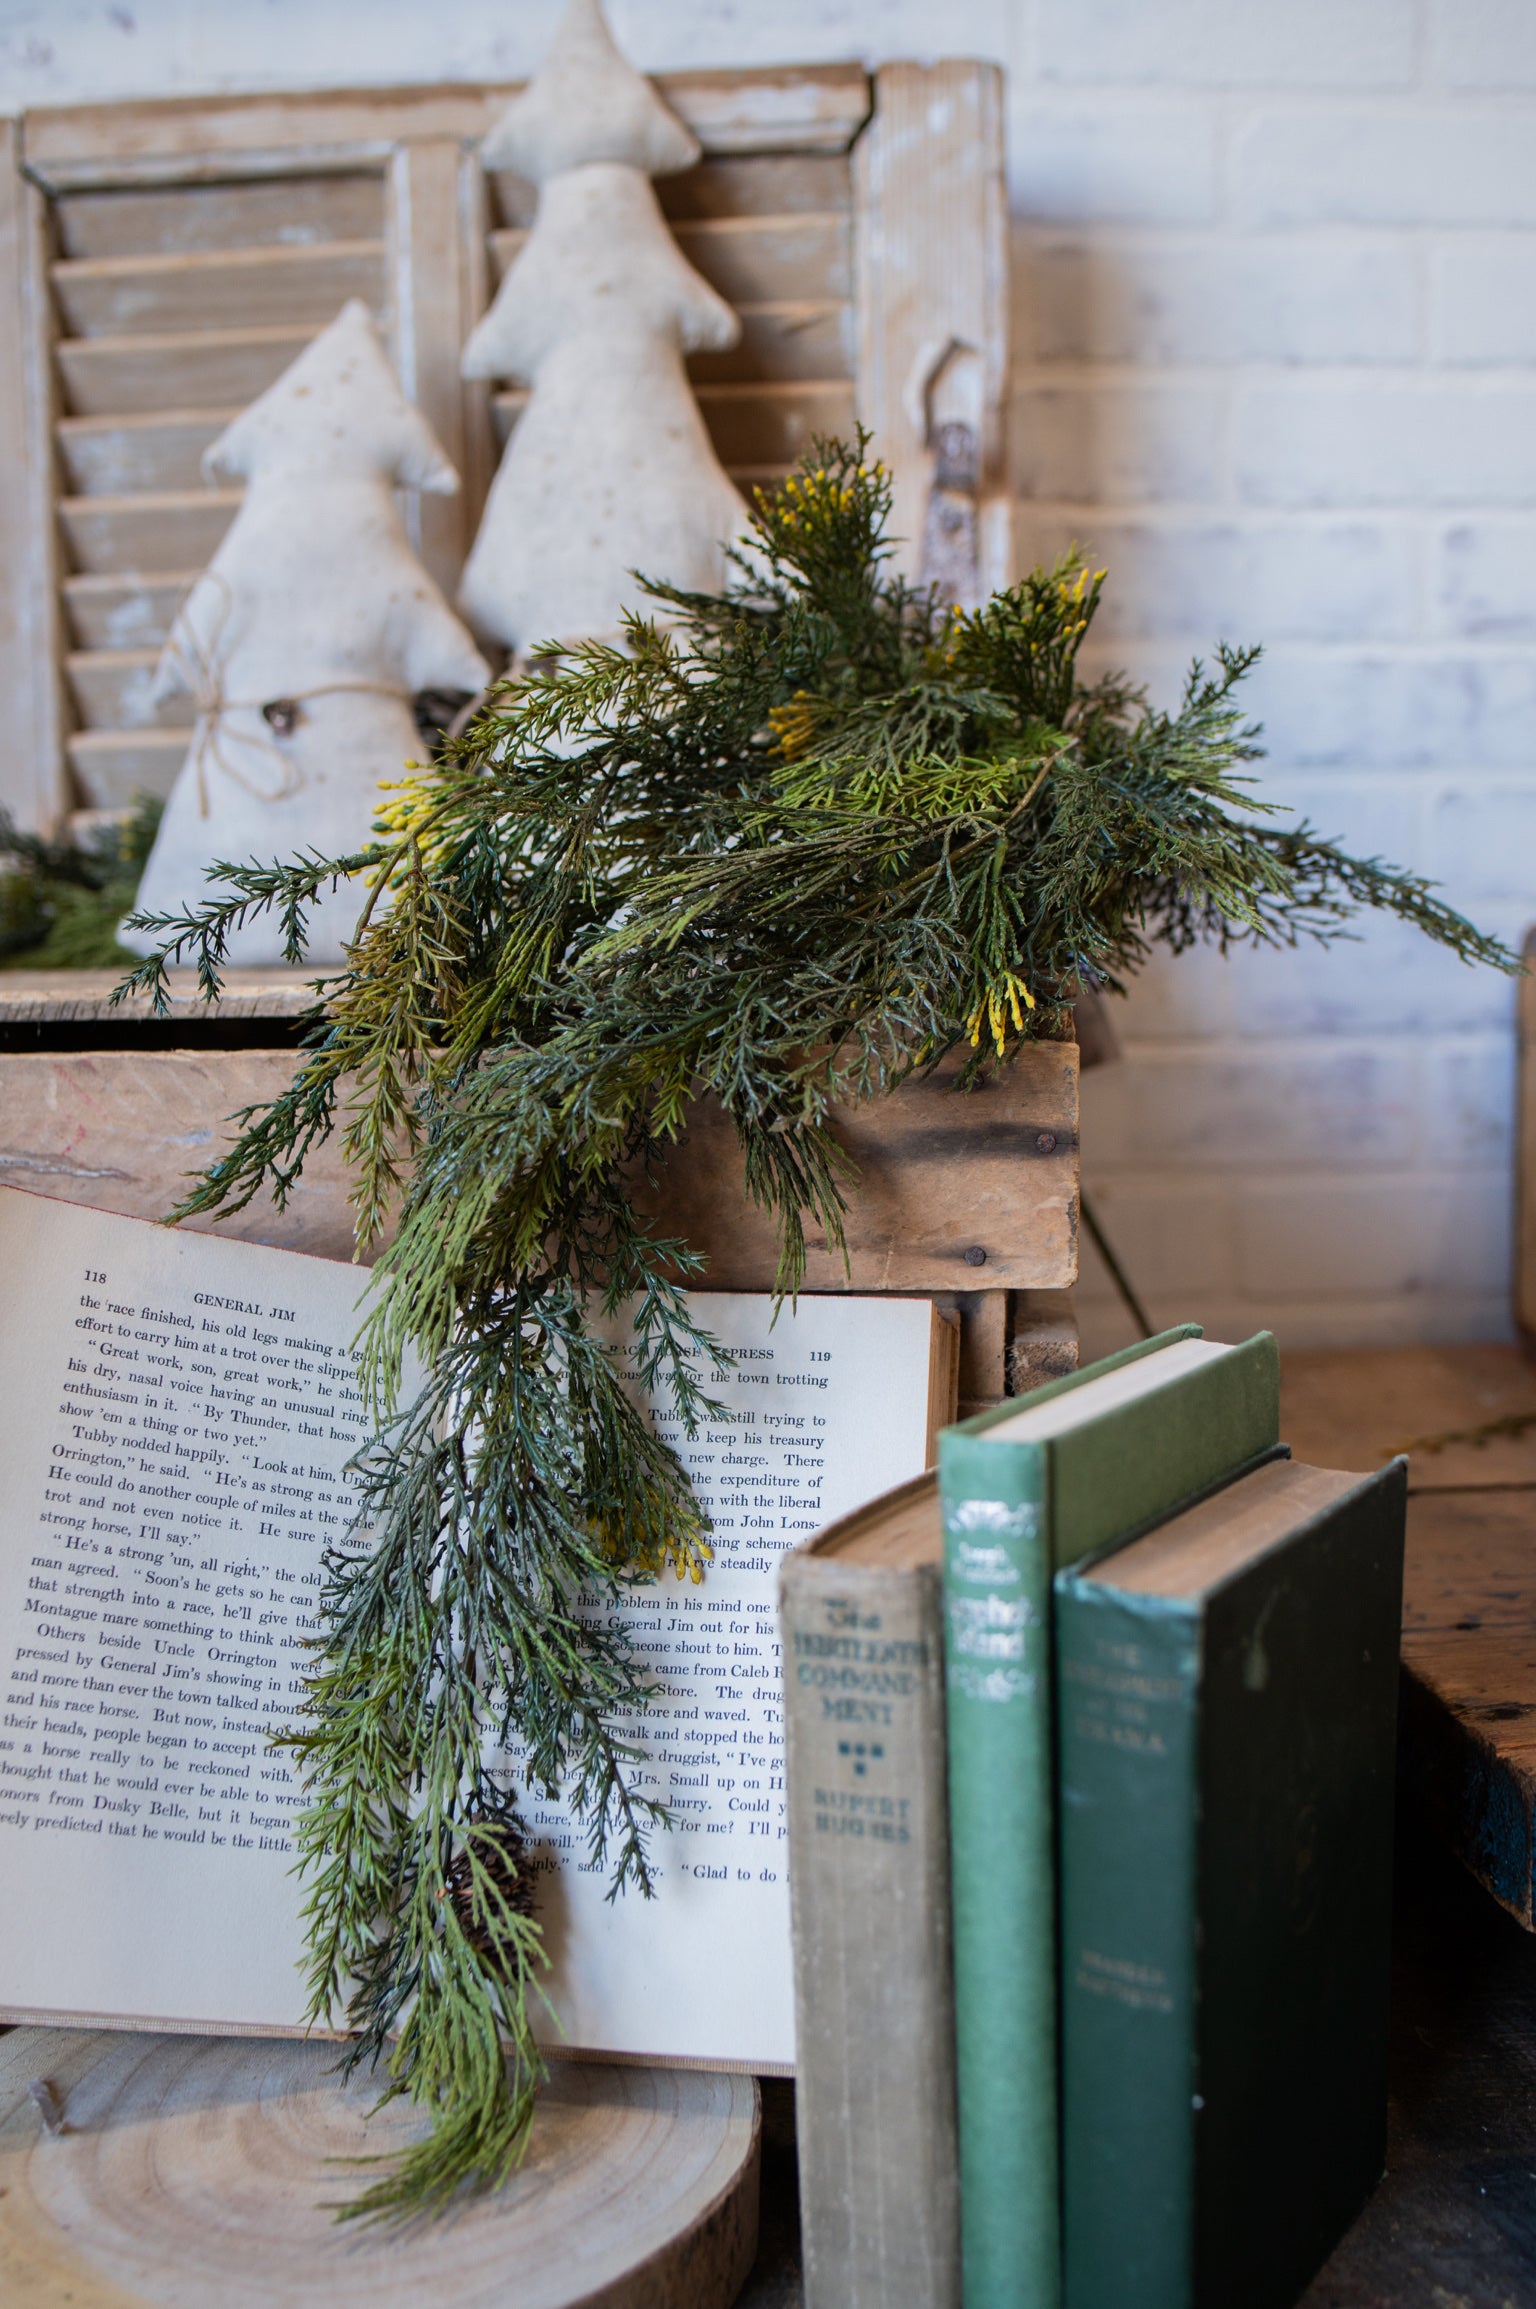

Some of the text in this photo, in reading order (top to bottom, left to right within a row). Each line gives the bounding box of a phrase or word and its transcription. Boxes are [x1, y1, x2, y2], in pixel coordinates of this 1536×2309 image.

[84, 1270, 107, 1284] 118
[193, 1292, 296, 1322] GENERAL JIM
[105, 1299, 333, 1358] race finished, legs making
[75, 1316, 290, 1368] effort carry trot over
[810, 1351, 832, 1362] 119
[147, 1355, 183, 1372] work,
[223, 1370, 259, 1384] great
[710, 1372, 829, 1389] the town trotting
[128, 1373, 370, 1427] nasal voice having unusual ring
[59, 1401, 179, 1436] show thing
[63, 1383, 356, 1443] enthusiasm Thunder, that hoss
[731, 1411, 805, 1429] still trying
[72, 1425, 229, 1466] Tubby nodded happily.
[706, 1430, 825, 1450] keep his treasury
[688, 1452, 824, 1468] new charge. There
[159, 1464, 190, 1480] said.
[270, 1483, 314, 1502] strong
[691, 1471, 712, 1484] the
[720, 1473, 800, 1488] expenditure
[75, 1473, 296, 1518] could another couple miles
[719, 1493, 821, 1509] with the liberal
[39, 1511, 87, 1531] strong
[91, 1517, 131, 1537] horse,
[45, 1489, 373, 1551] trot even notice sure some
[740, 1515, 820, 1529] John Lons-
[118, 1546, 165, 1567] strong
[720, 1557, 772, 1574] steadily
[67, 1563, 244, 1598] agreed. gets
[29, 1576, 58, 1592] that
[65, 1583, 125, 1603] strength
[132, 1591, 160, 1607] into
[182, 1602, 214, 1617] race,
[258, 1610, 288, 1626] give
[296, 1616, 322, 1630] that
[577, 1594, 770, 1613] this his mind one
[24, 1598, 274, 1646] Montague mare something think
[667, 1618, 774, 1635] Jim out for his
[37, 1623, 322, 1674] Others beside Uncle Orrington were
[674, 1640, 762, 1656] shout him.
[15, 1648, 69, 1663] pressed
[100, 1655, 157, 1675] General
[206, 1670, 263, 1692] showing
[655, 1663, 769, 1678] came from Caleb
[41, 1675, 259, 1711] more than ever town talked
[715, 1685, 743, 1699] The
[64, 1701, 271, 1735] race horse. instead
[613, 1704, 750, 1721] his store and waved.
[4, 1713, 256, 1758] their heads, people began accept
[654, 1727, 764, 1746] and stopped the
[42, 1741, 293, 1783] horse really reckoned with.
[658, 1749, 720, 1767] druggist,
[629, 1770, 709, 1787] Mrs. Small
[117, 1777, 312, 1807] would wrest
[669, 1797, 770, 1813] hurry. Could
[535, 1811, 571, 1827] there,
[680, 1818, 769, 1835] for me? I’ll
[34, 1816, 292, 1852] predicted little
[546, 1835, 583, 1848] will.”
